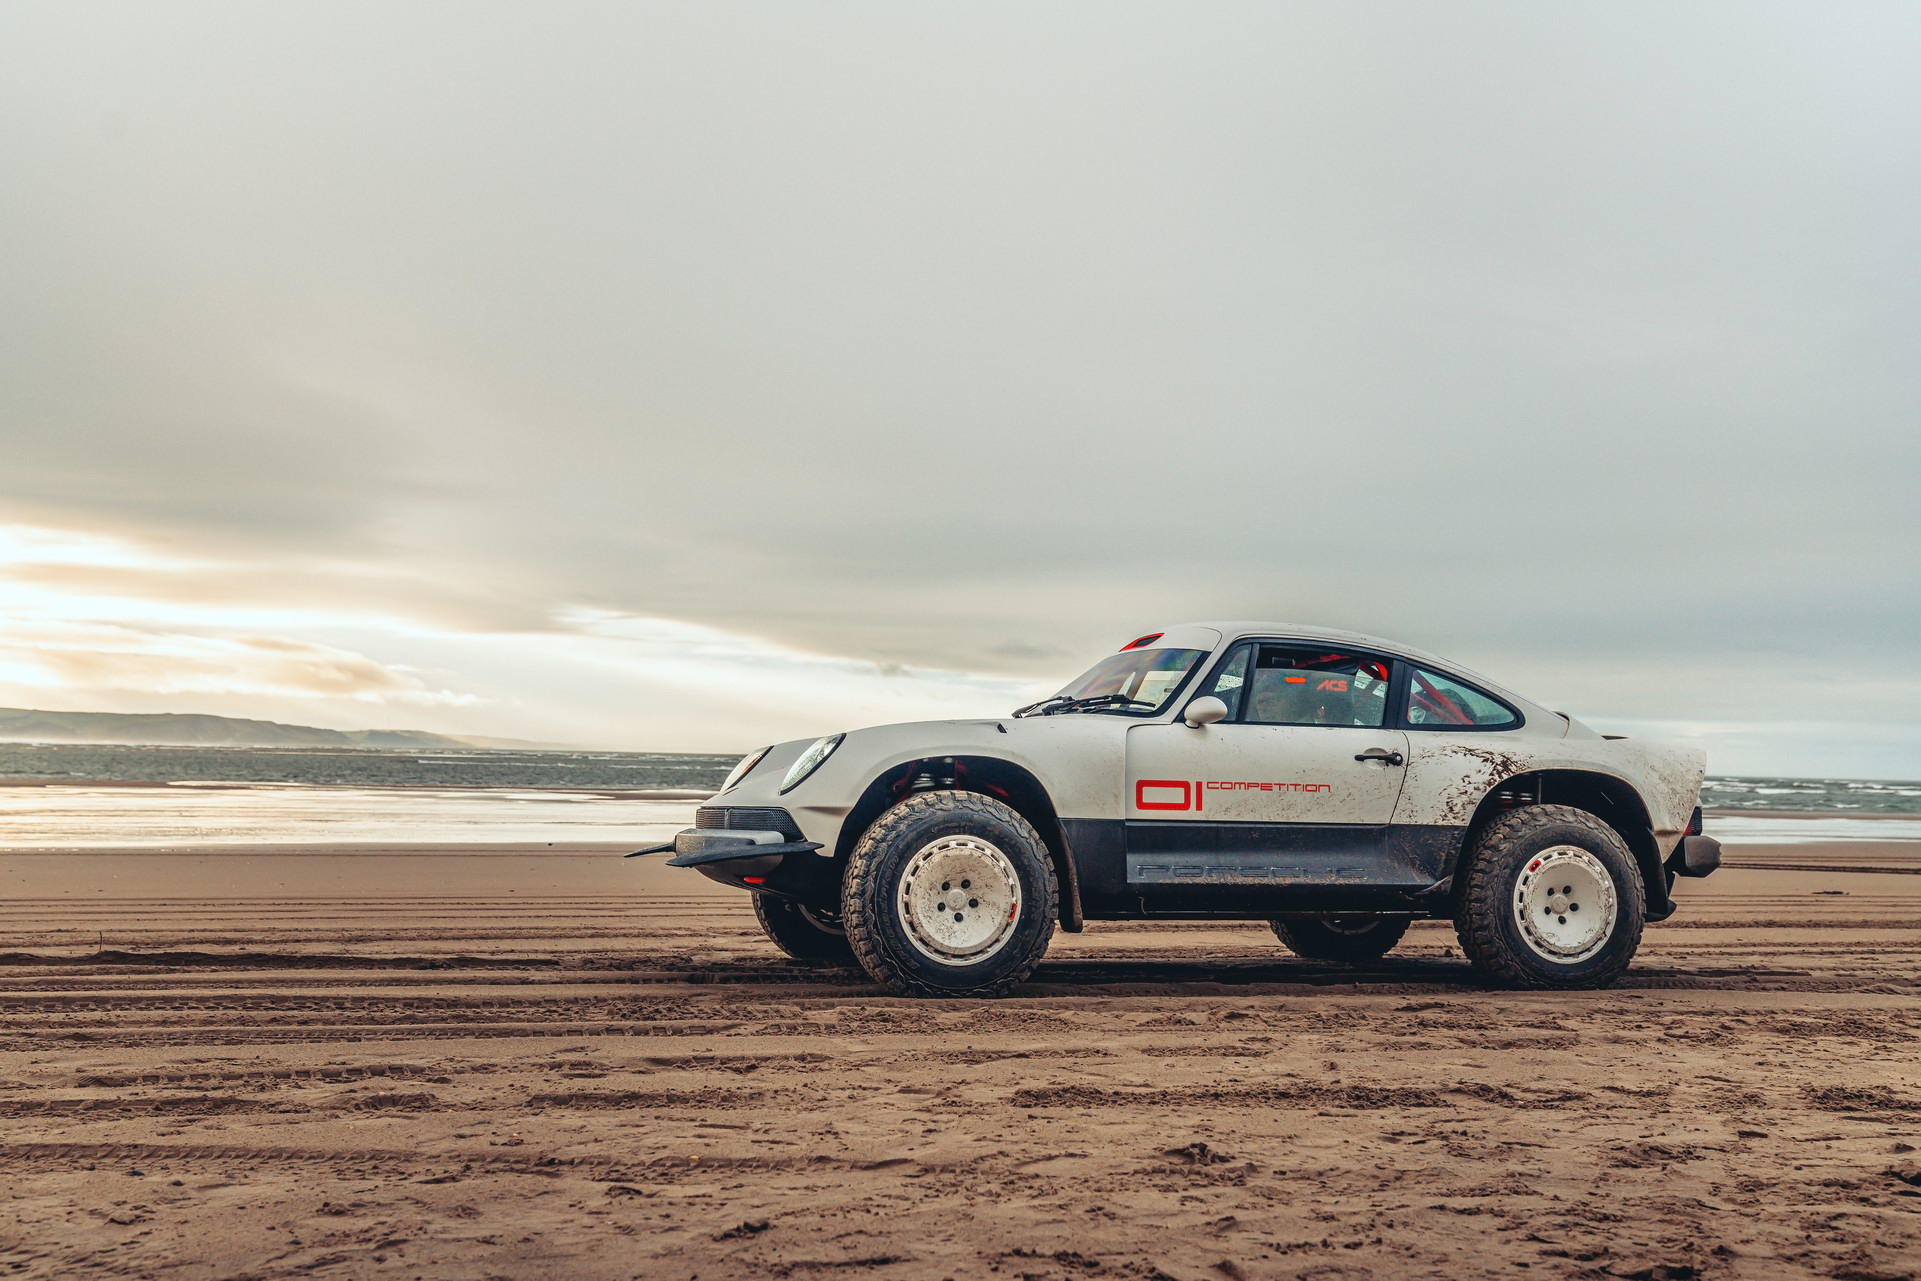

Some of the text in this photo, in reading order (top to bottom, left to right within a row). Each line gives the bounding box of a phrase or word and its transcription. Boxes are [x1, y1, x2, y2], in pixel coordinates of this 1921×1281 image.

[1316, 680, 1348, 692] ACS
[1206, 781, 1331, 792] COMPETITION
[1137, 865, 1368, 880] PORSCHE
